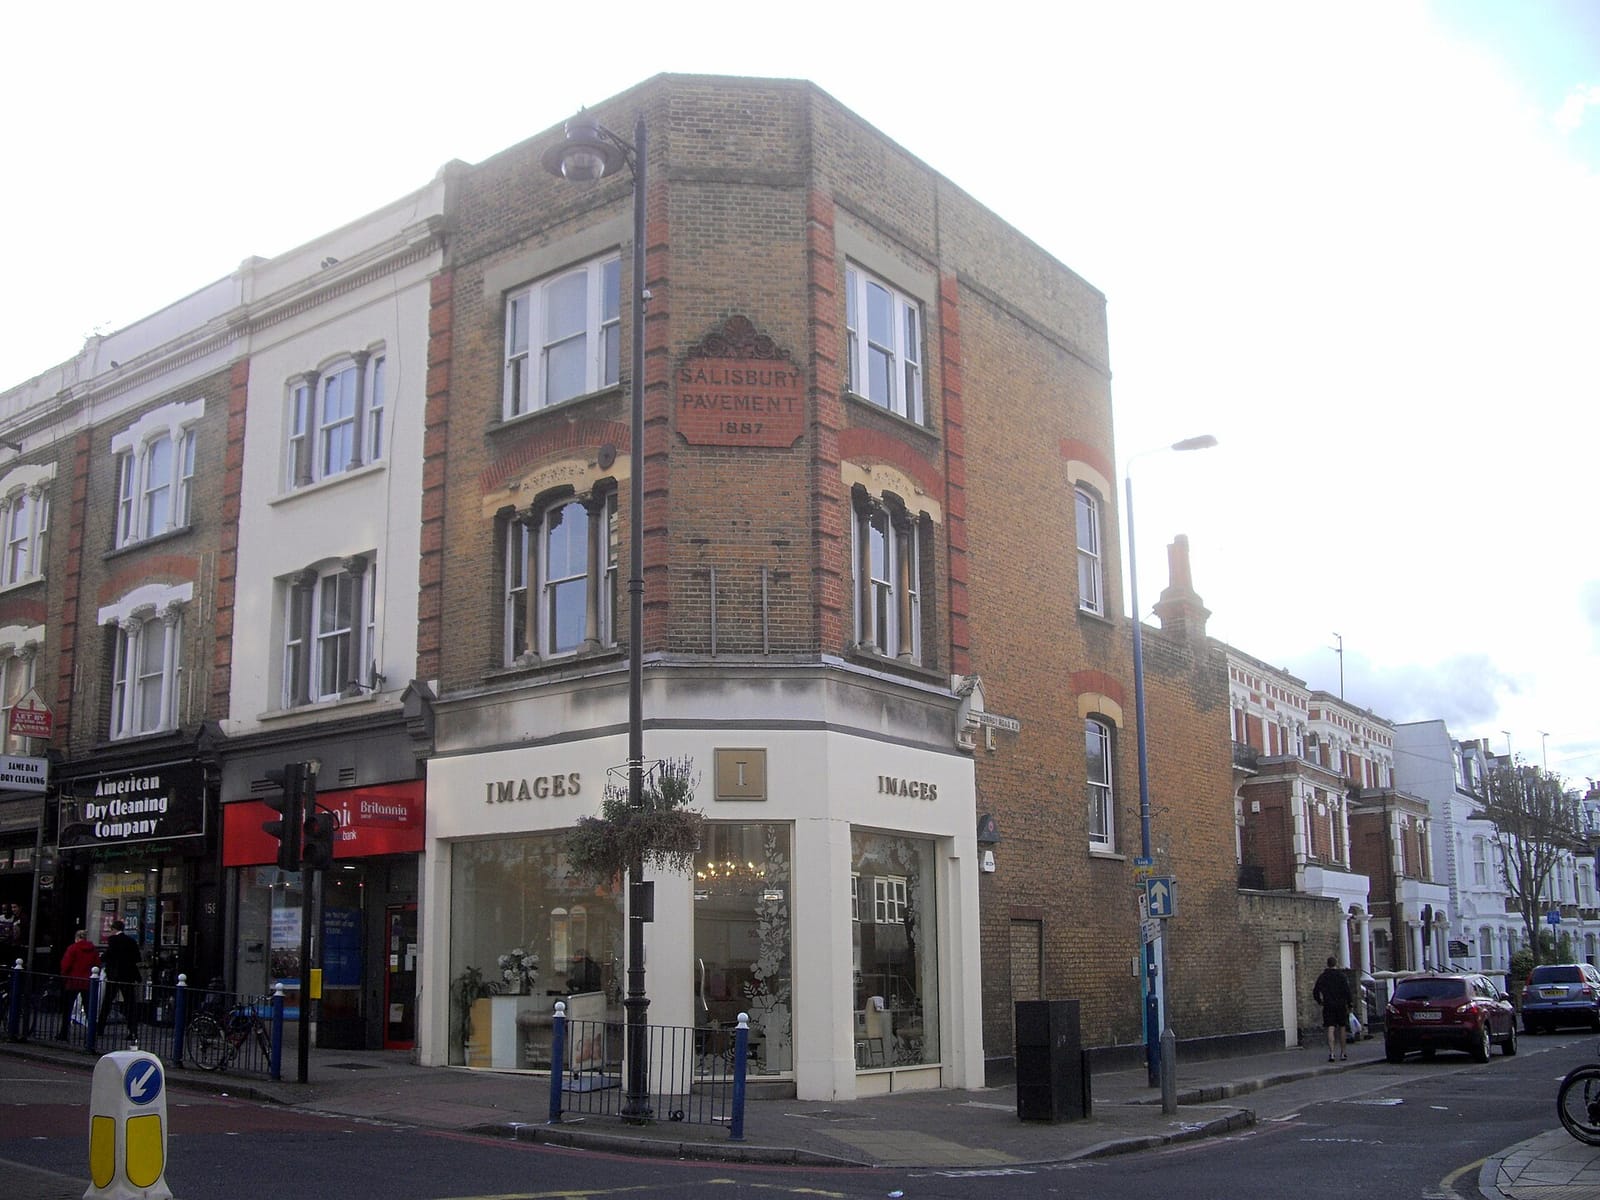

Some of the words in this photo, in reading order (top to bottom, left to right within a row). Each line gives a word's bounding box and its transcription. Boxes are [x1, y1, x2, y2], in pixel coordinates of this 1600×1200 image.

[680, 368, 800, 388] SALISBURY
[682, 394, 797, 412] PAVEMENT
[719, 422, 763, 434] 1887
[8, 762, 24, 771] SAME
[25, 764, 38, 772] DAY
[0, 773, 13, 782] DRY
[15, 774, 45, 785] CLEANING
[95, 776, 160, 796] American
[877, 775, 937, 801] IMAGES
[485, 773, 581, 804] IMAGES
[86, 803, 108, 819] Dry
[109, 797, 168, 816] Cleaning
[360, 800, 407, 816] Britannia
[95, 819, 158, 837] Company
[342, 830, 357, 840] bank
